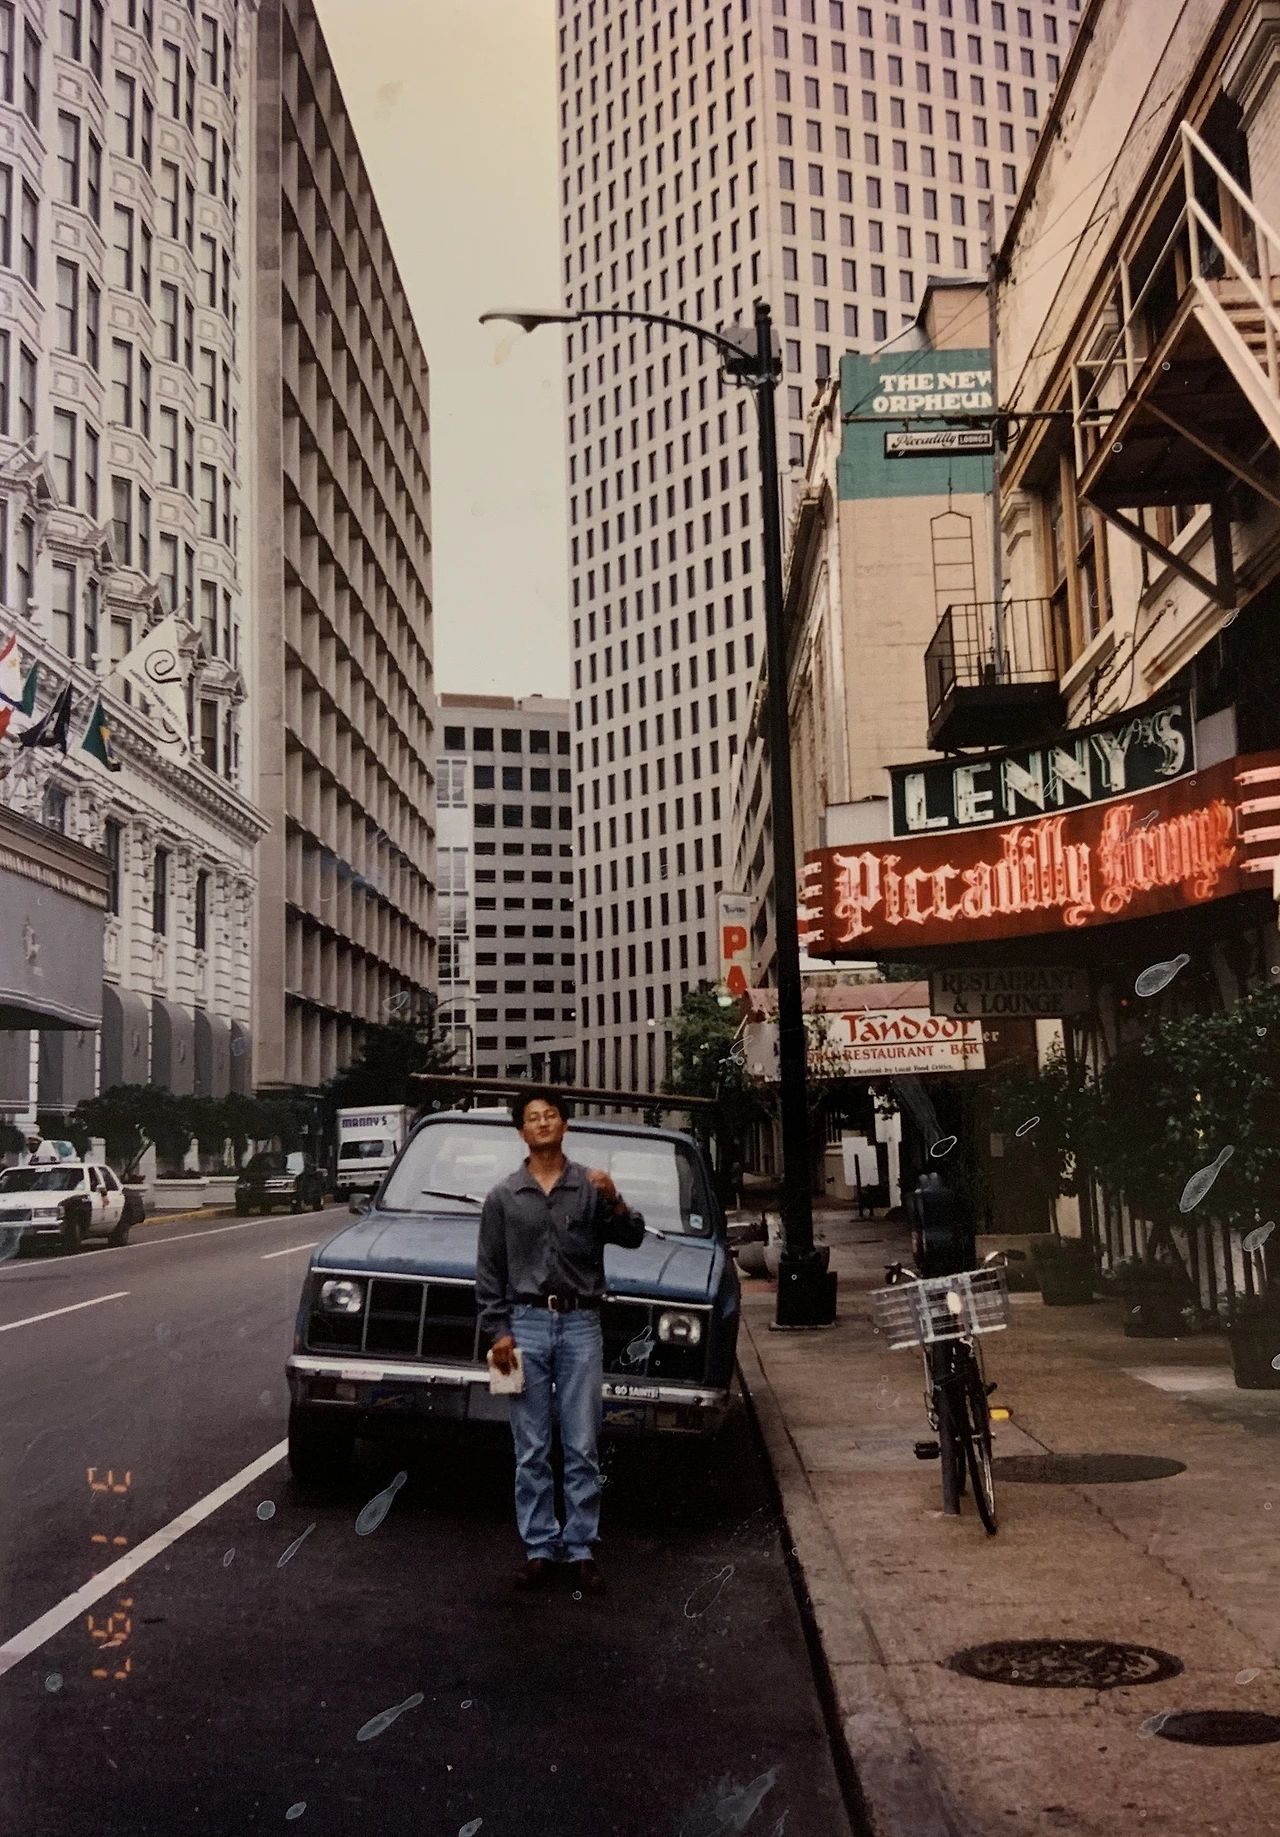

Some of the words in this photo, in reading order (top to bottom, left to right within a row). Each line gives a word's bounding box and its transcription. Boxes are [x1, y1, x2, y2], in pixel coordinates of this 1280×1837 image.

[880, 373, 934, 393] THE
[891, 433, 958, 456] Piccadilly
[959, 435, 989, 445] LOUNGE
[904, 705, 1185, 831] LENNY'S
[833, 816, 1095, 943] Piccadilly
[941, 969, 1076, 993] RESTAURANT
[953, 994, 969, 1014] &
[980, 993, 1063, 1014] LOUNGE
[844, 1045, 934, 1061] RESTAURANT
[951, 1044, 980, 1055] BAR
